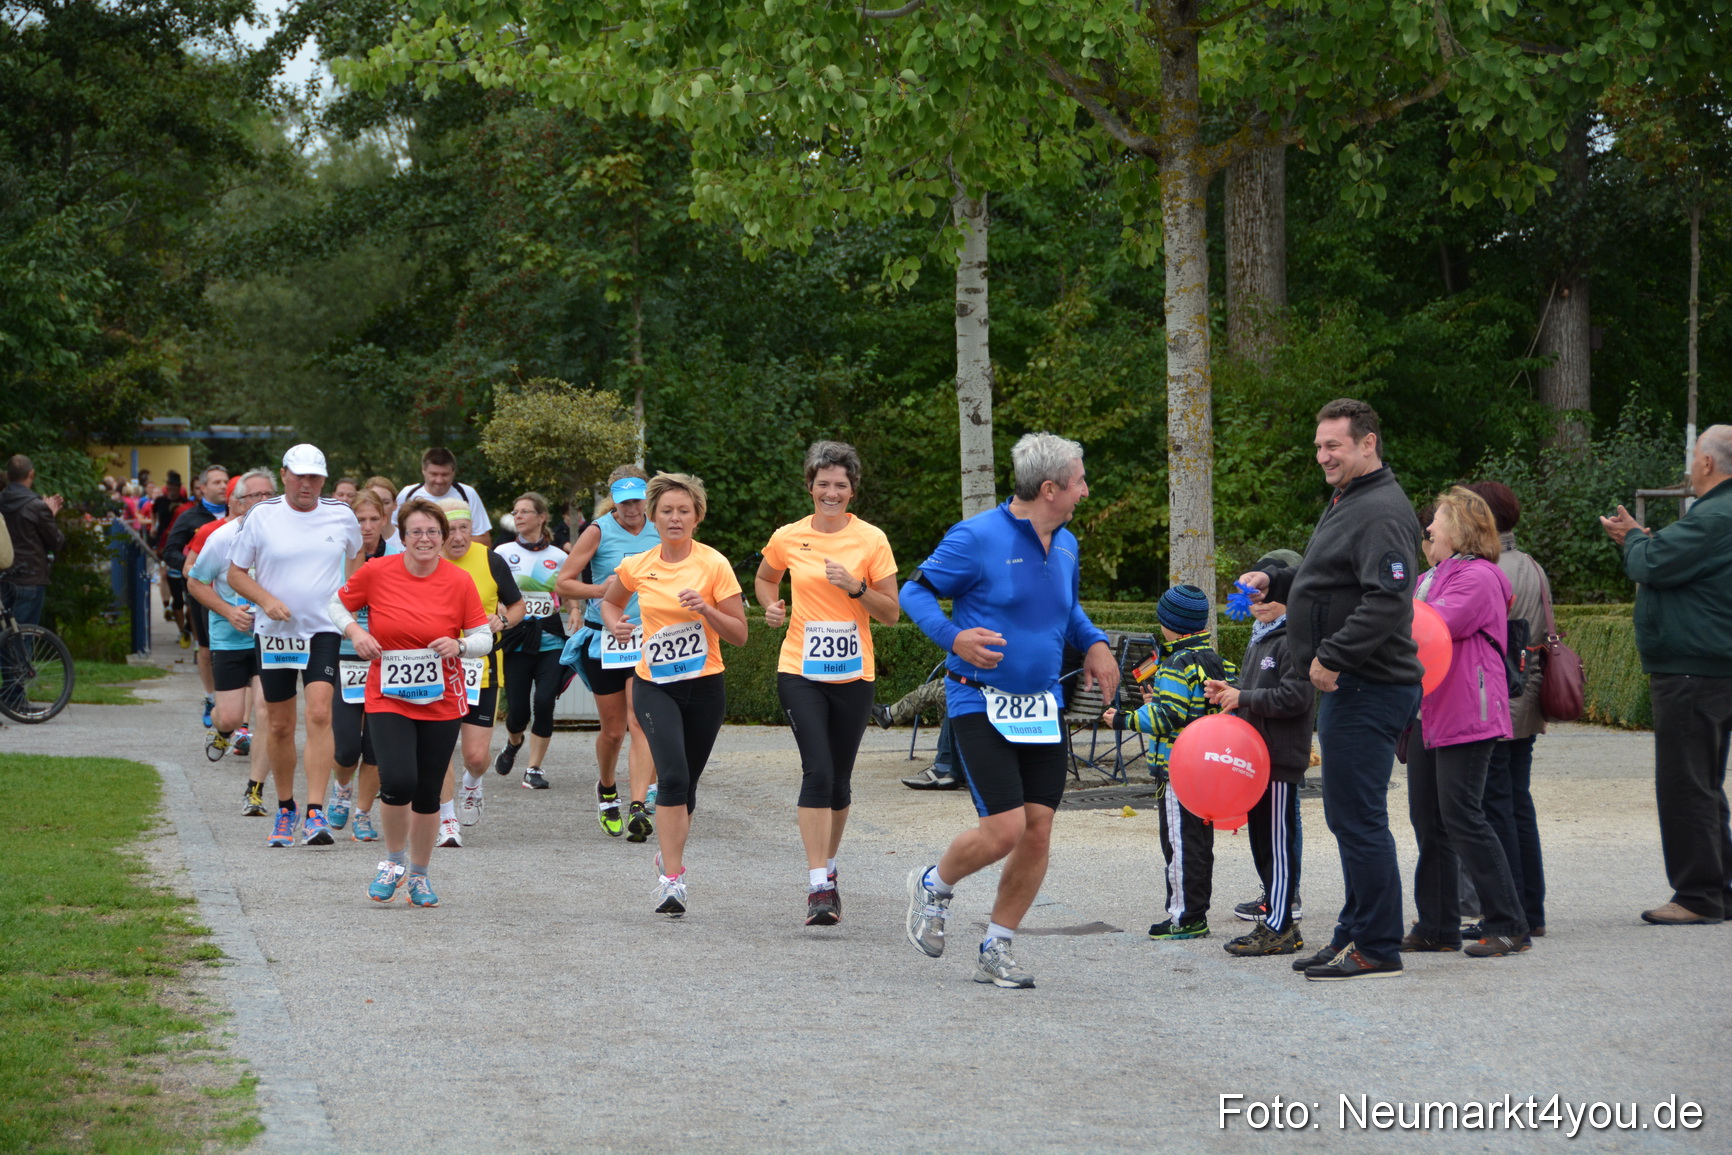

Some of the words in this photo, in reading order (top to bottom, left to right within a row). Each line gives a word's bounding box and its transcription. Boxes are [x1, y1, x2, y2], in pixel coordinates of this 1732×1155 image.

[525, 600, 551, 615] 326
[663, 626, 693, 638] Neumarkt
[649, 633, 703, 663] 2322
[809, 634, 858, 658] 2396
[274, 654, 299, 662] Werner
[619, 654, 638, 662] Petra
[387, 662, 438, 685] 2323
[673, 663, 687, 673] Evi
[824, 663, 847, 673] Heidi
[347, 670, 368, 685] 22
[398, 688, 429, 699] Monika
[994, 694, 1049, 720] 2821
[1008, 725, 1043, 735] Thomas
